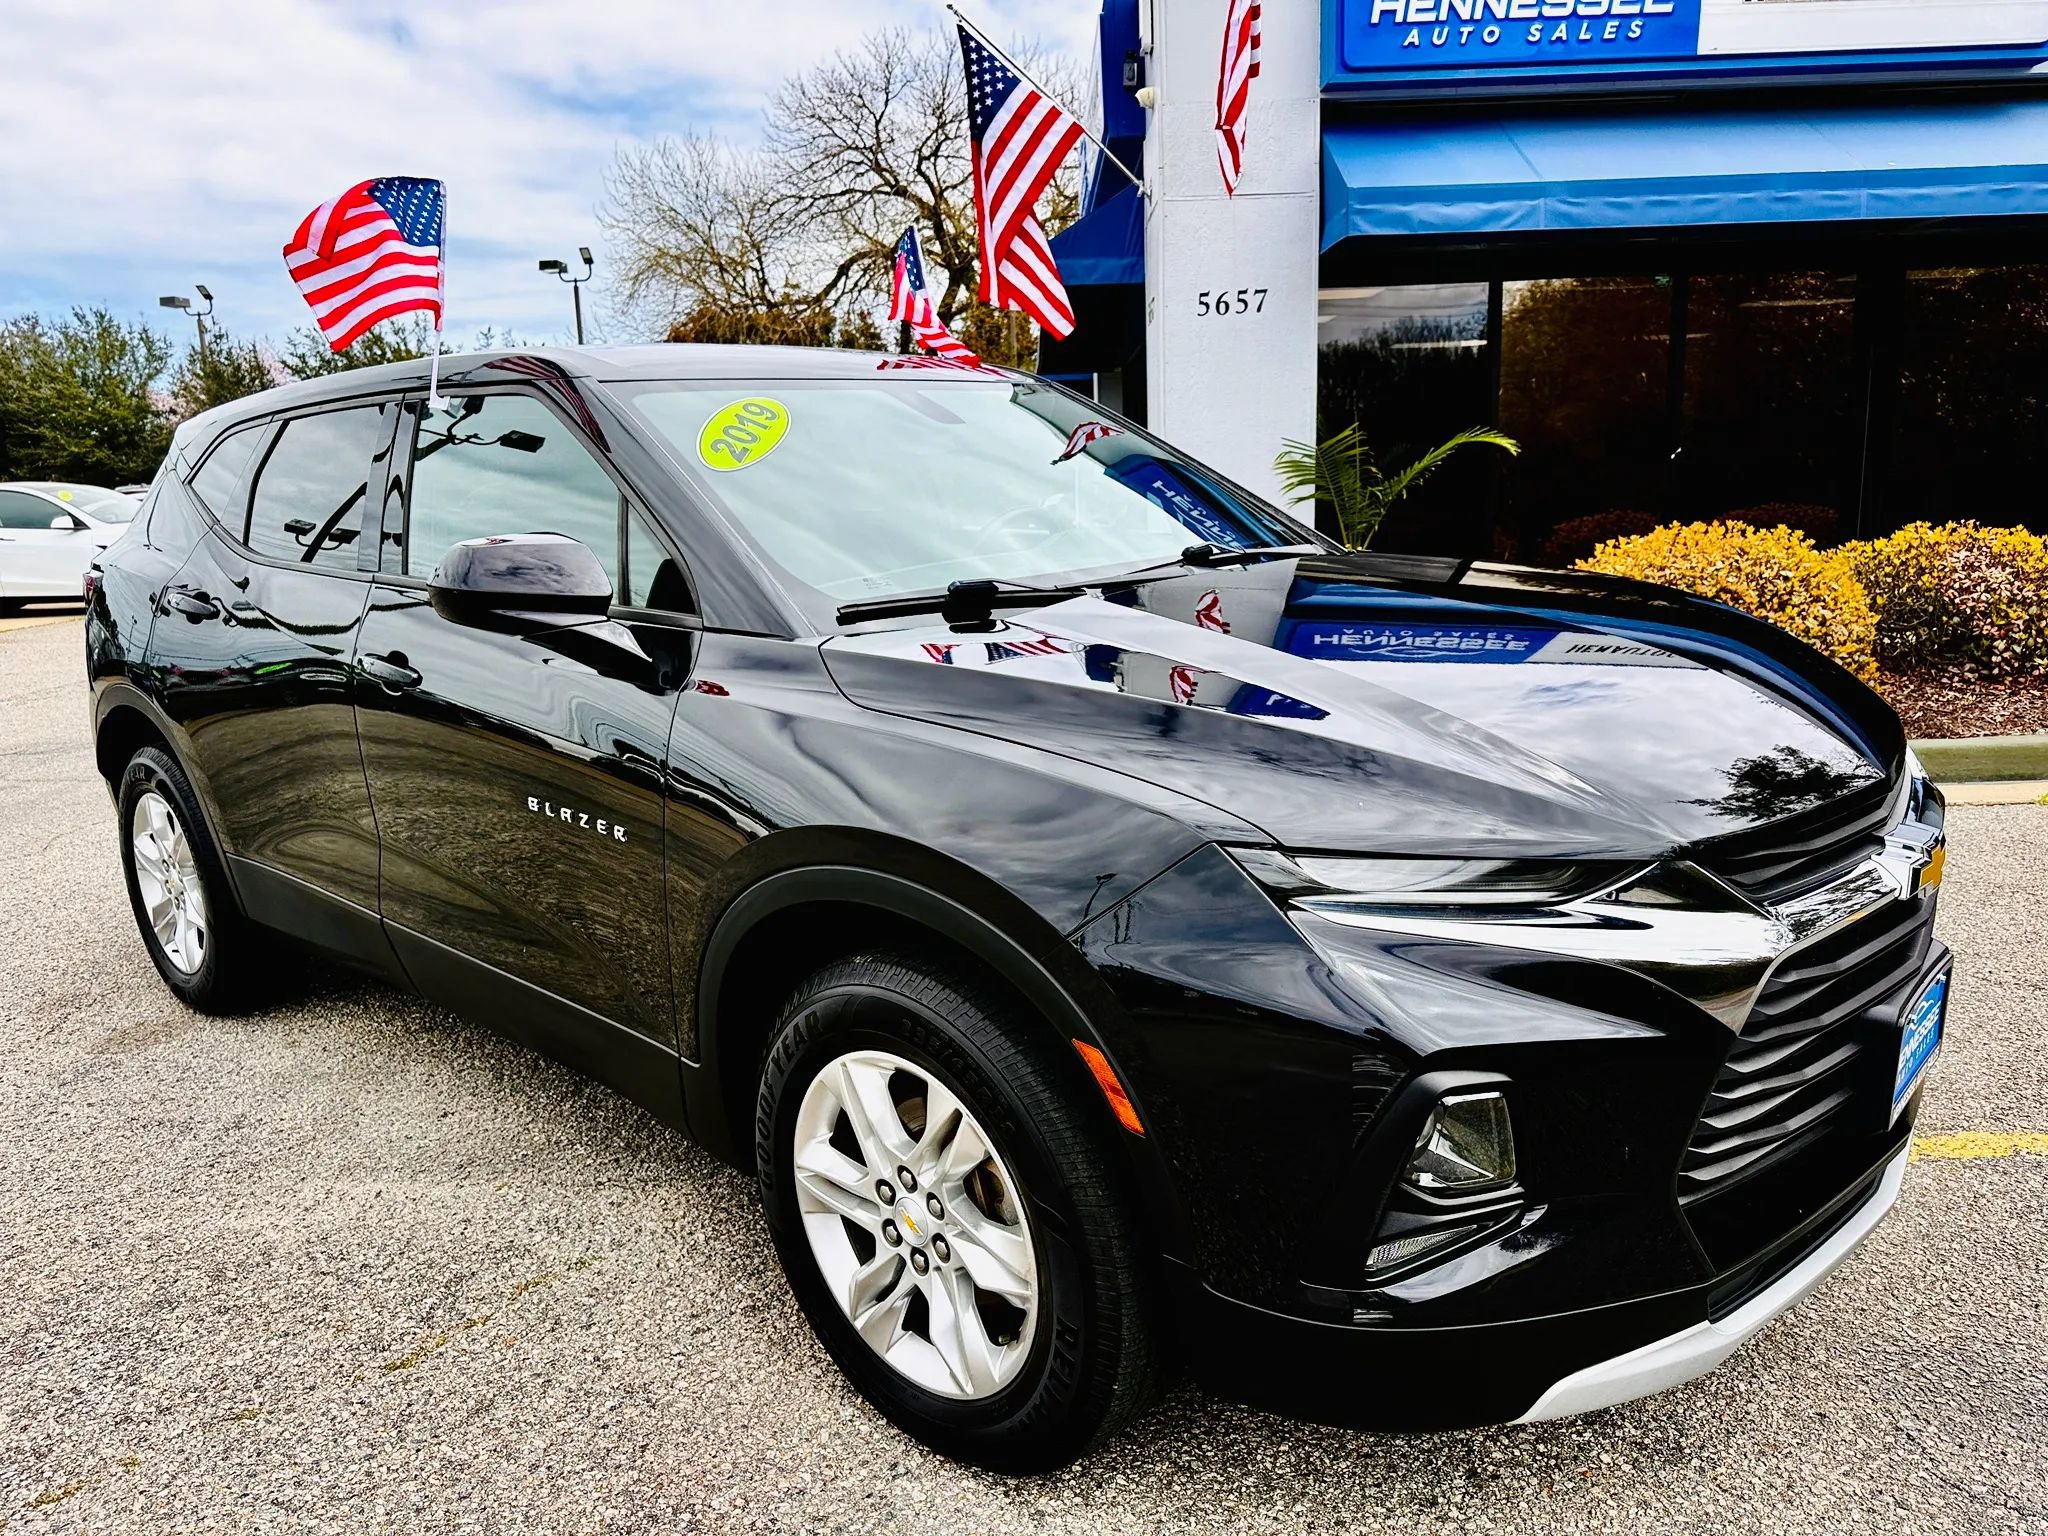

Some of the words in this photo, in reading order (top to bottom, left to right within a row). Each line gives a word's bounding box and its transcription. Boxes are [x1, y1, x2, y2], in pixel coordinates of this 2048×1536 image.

[1403, 24, 1500, 47] AUTO
[1527, 19, 1643, 42] SALES
[1197, 288, 1268, 317] 5657
[710, 402, 778, 464] 2019
[527, 796, 628, 842] BLAZER
[1898, 1001, 1941, 1073] ENNESSEE
